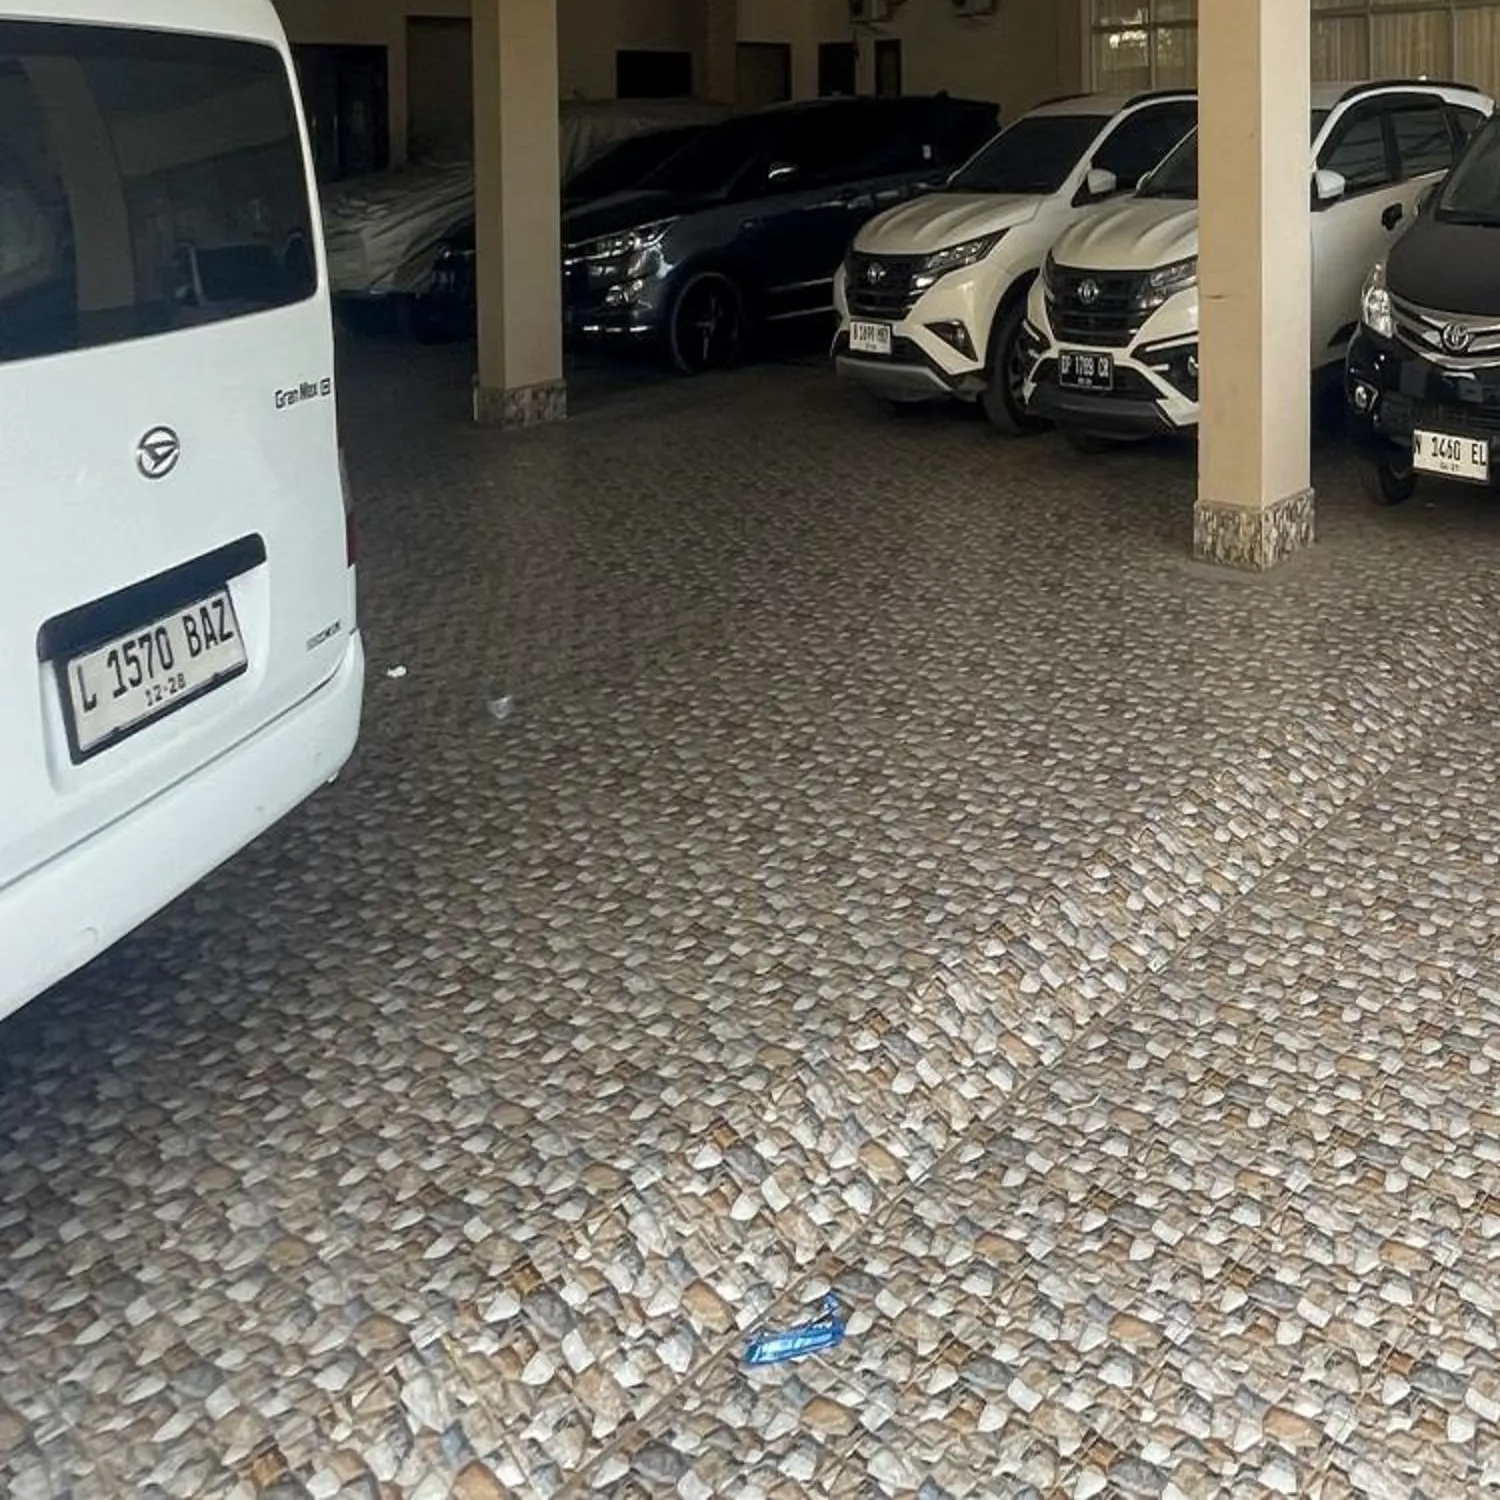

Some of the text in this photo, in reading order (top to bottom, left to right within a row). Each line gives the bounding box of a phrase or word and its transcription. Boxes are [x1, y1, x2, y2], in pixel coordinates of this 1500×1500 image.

[77, 598, 234, 712] L 1570 BAZ
